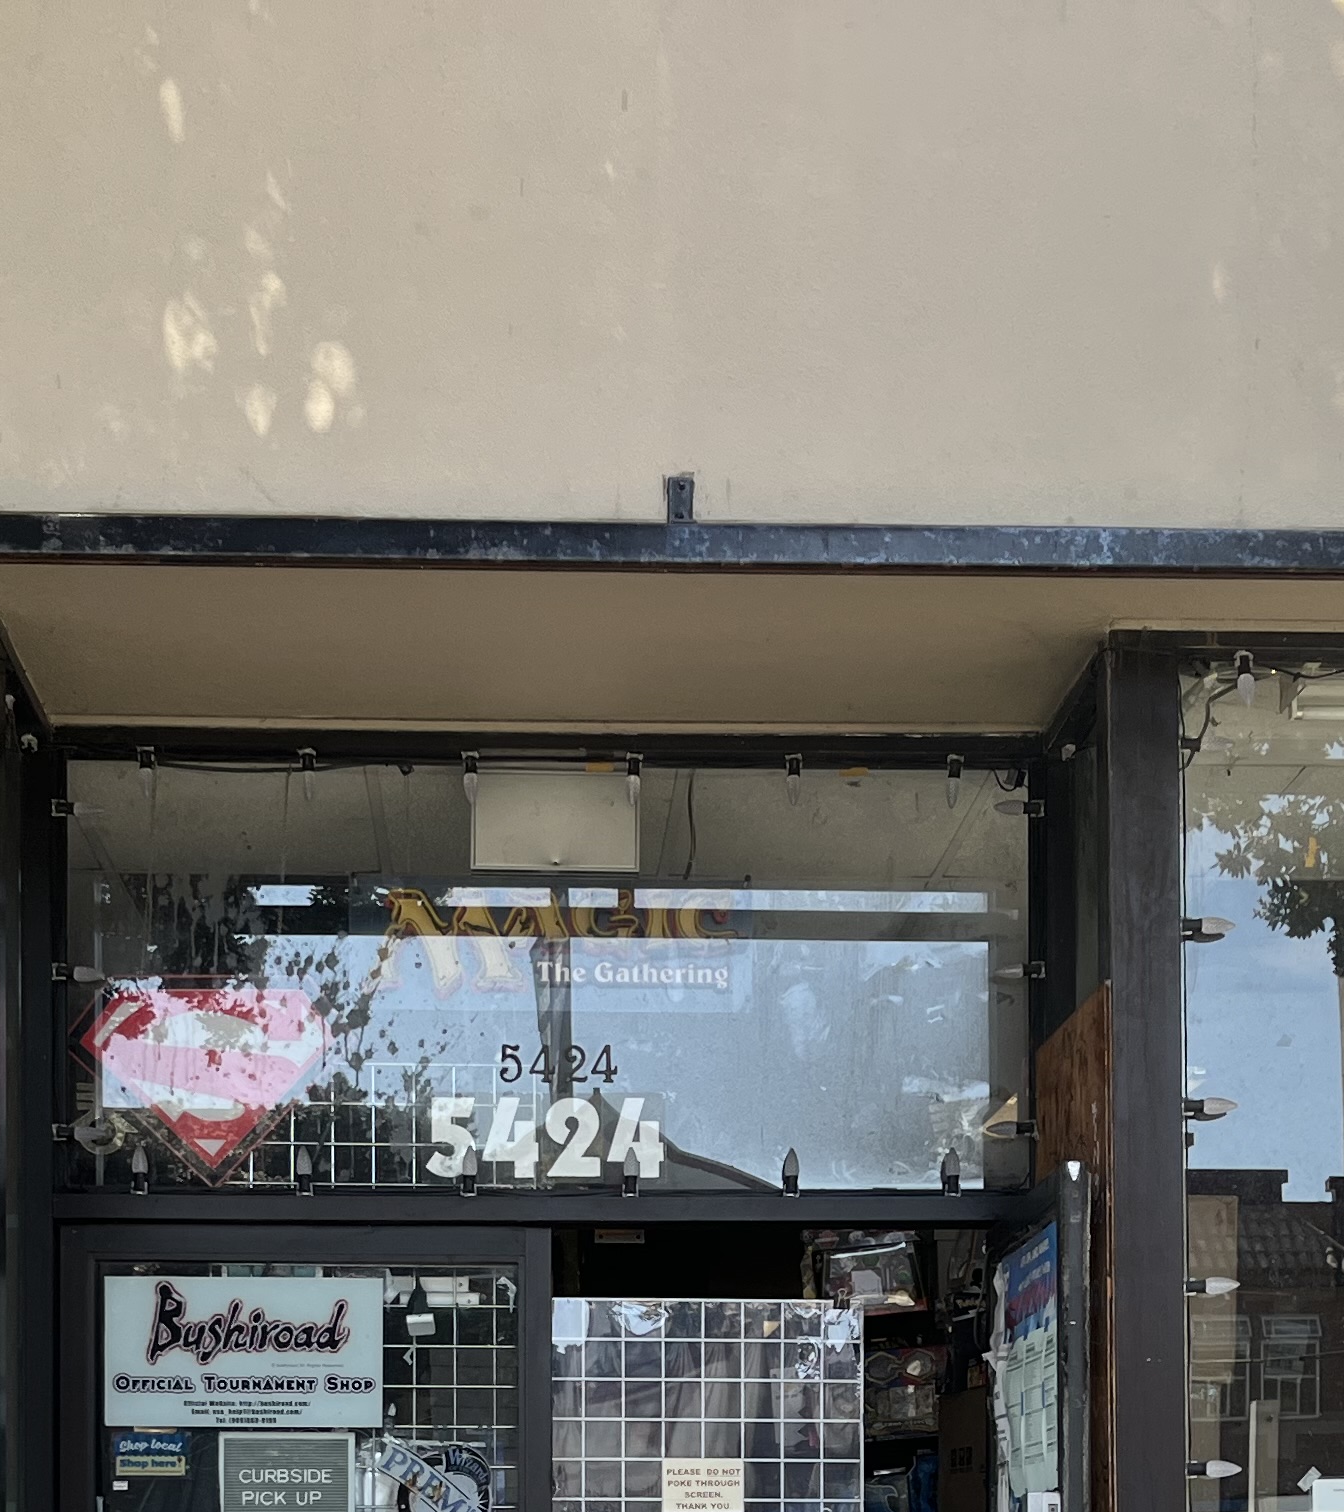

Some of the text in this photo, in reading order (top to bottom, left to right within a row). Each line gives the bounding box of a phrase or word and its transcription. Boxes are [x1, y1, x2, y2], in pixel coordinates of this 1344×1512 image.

[537, 961, 728, 989] The Gathering
[499, 1044, 618, 1083] 5424
[426, 1097, 665, 1179] 5424
[146, 1280, 350, 1366] Bushiroad
[119, 1439, 183, 1453] Shop local
[119, 1459, 149, 1469] Shop
[666, 1468, 741, 1476] PLEASE DO NOT
[238, 1468, 333, 1484] CURBSIDE
[241, 1491, 322, 1506] PICK UP
